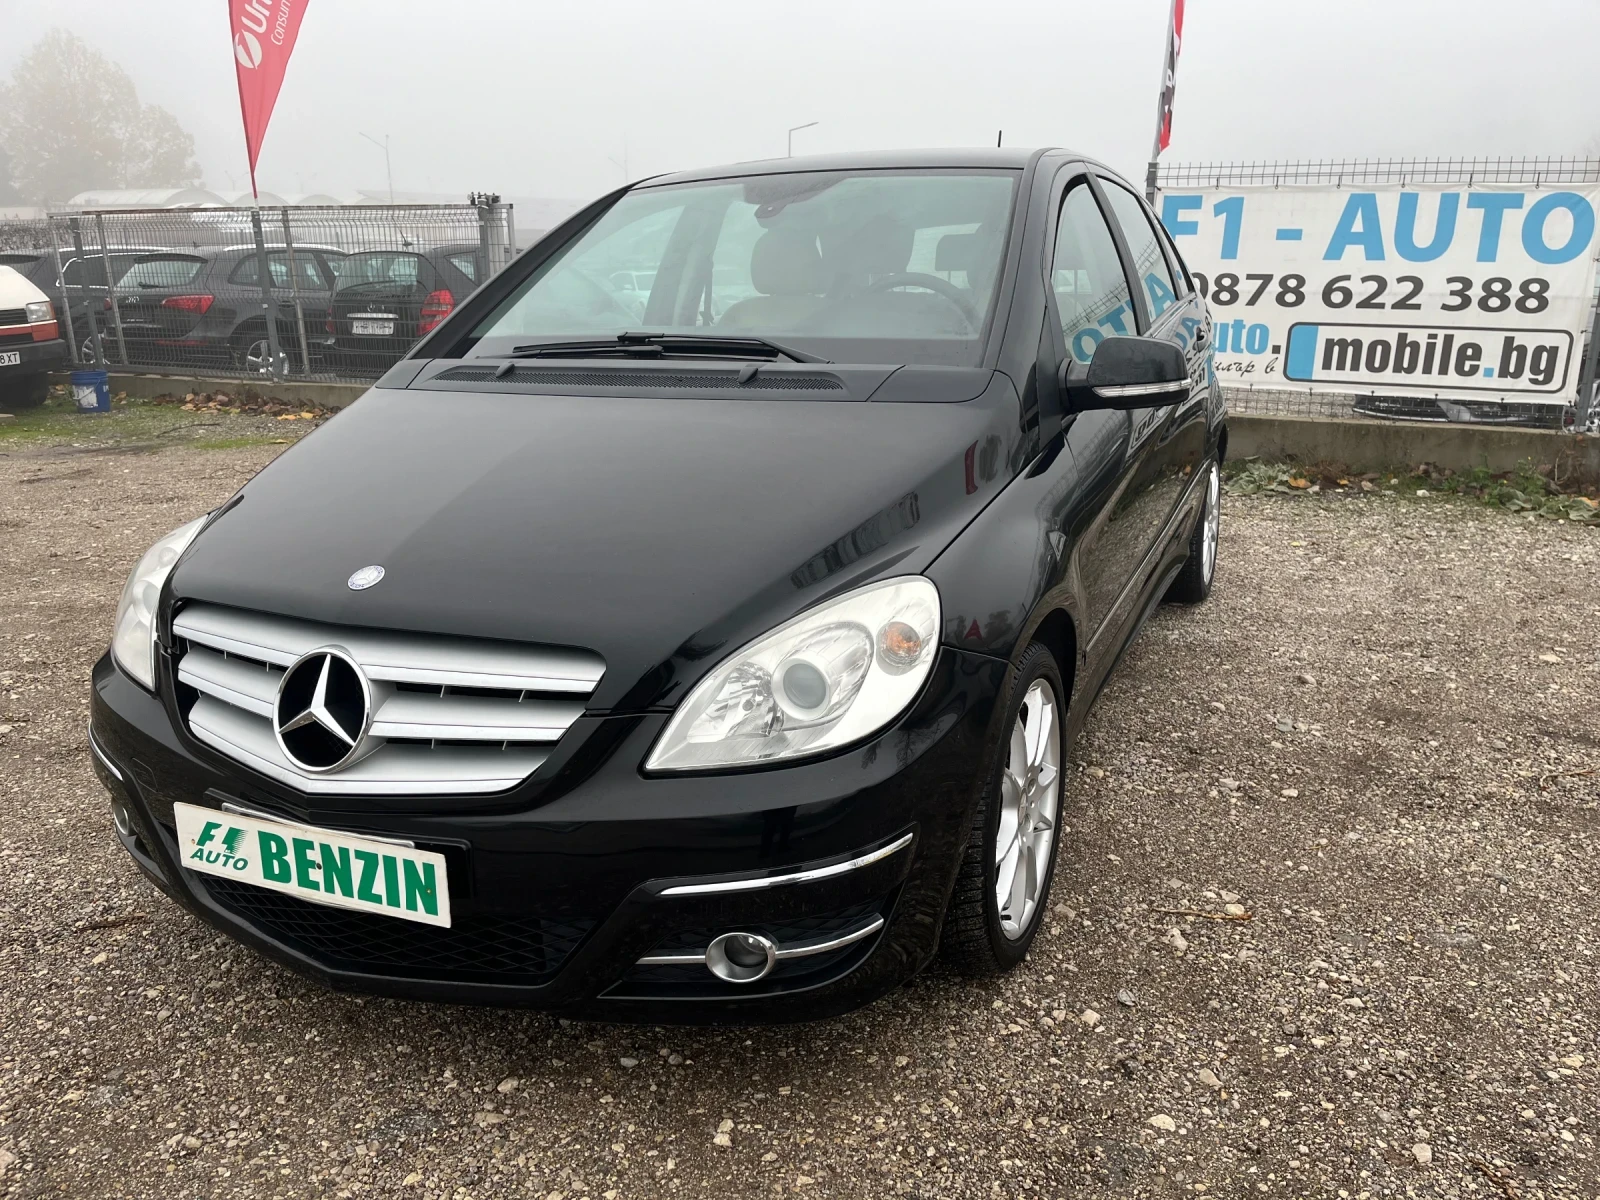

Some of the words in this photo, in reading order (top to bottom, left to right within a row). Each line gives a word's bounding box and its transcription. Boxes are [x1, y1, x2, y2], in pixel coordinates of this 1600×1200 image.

[1161, 194, 1245, 260] F1
[1323, 191, 1596, 265] AUTO
[1321, 274, 1423, 311] 622
[1440, 275, 1551, 314] 388
[1321, 331, 1560, 386] mobile.bg
[190, 847, 249, 871] AUTO
[257, 830, 439, 917] BENZIN
